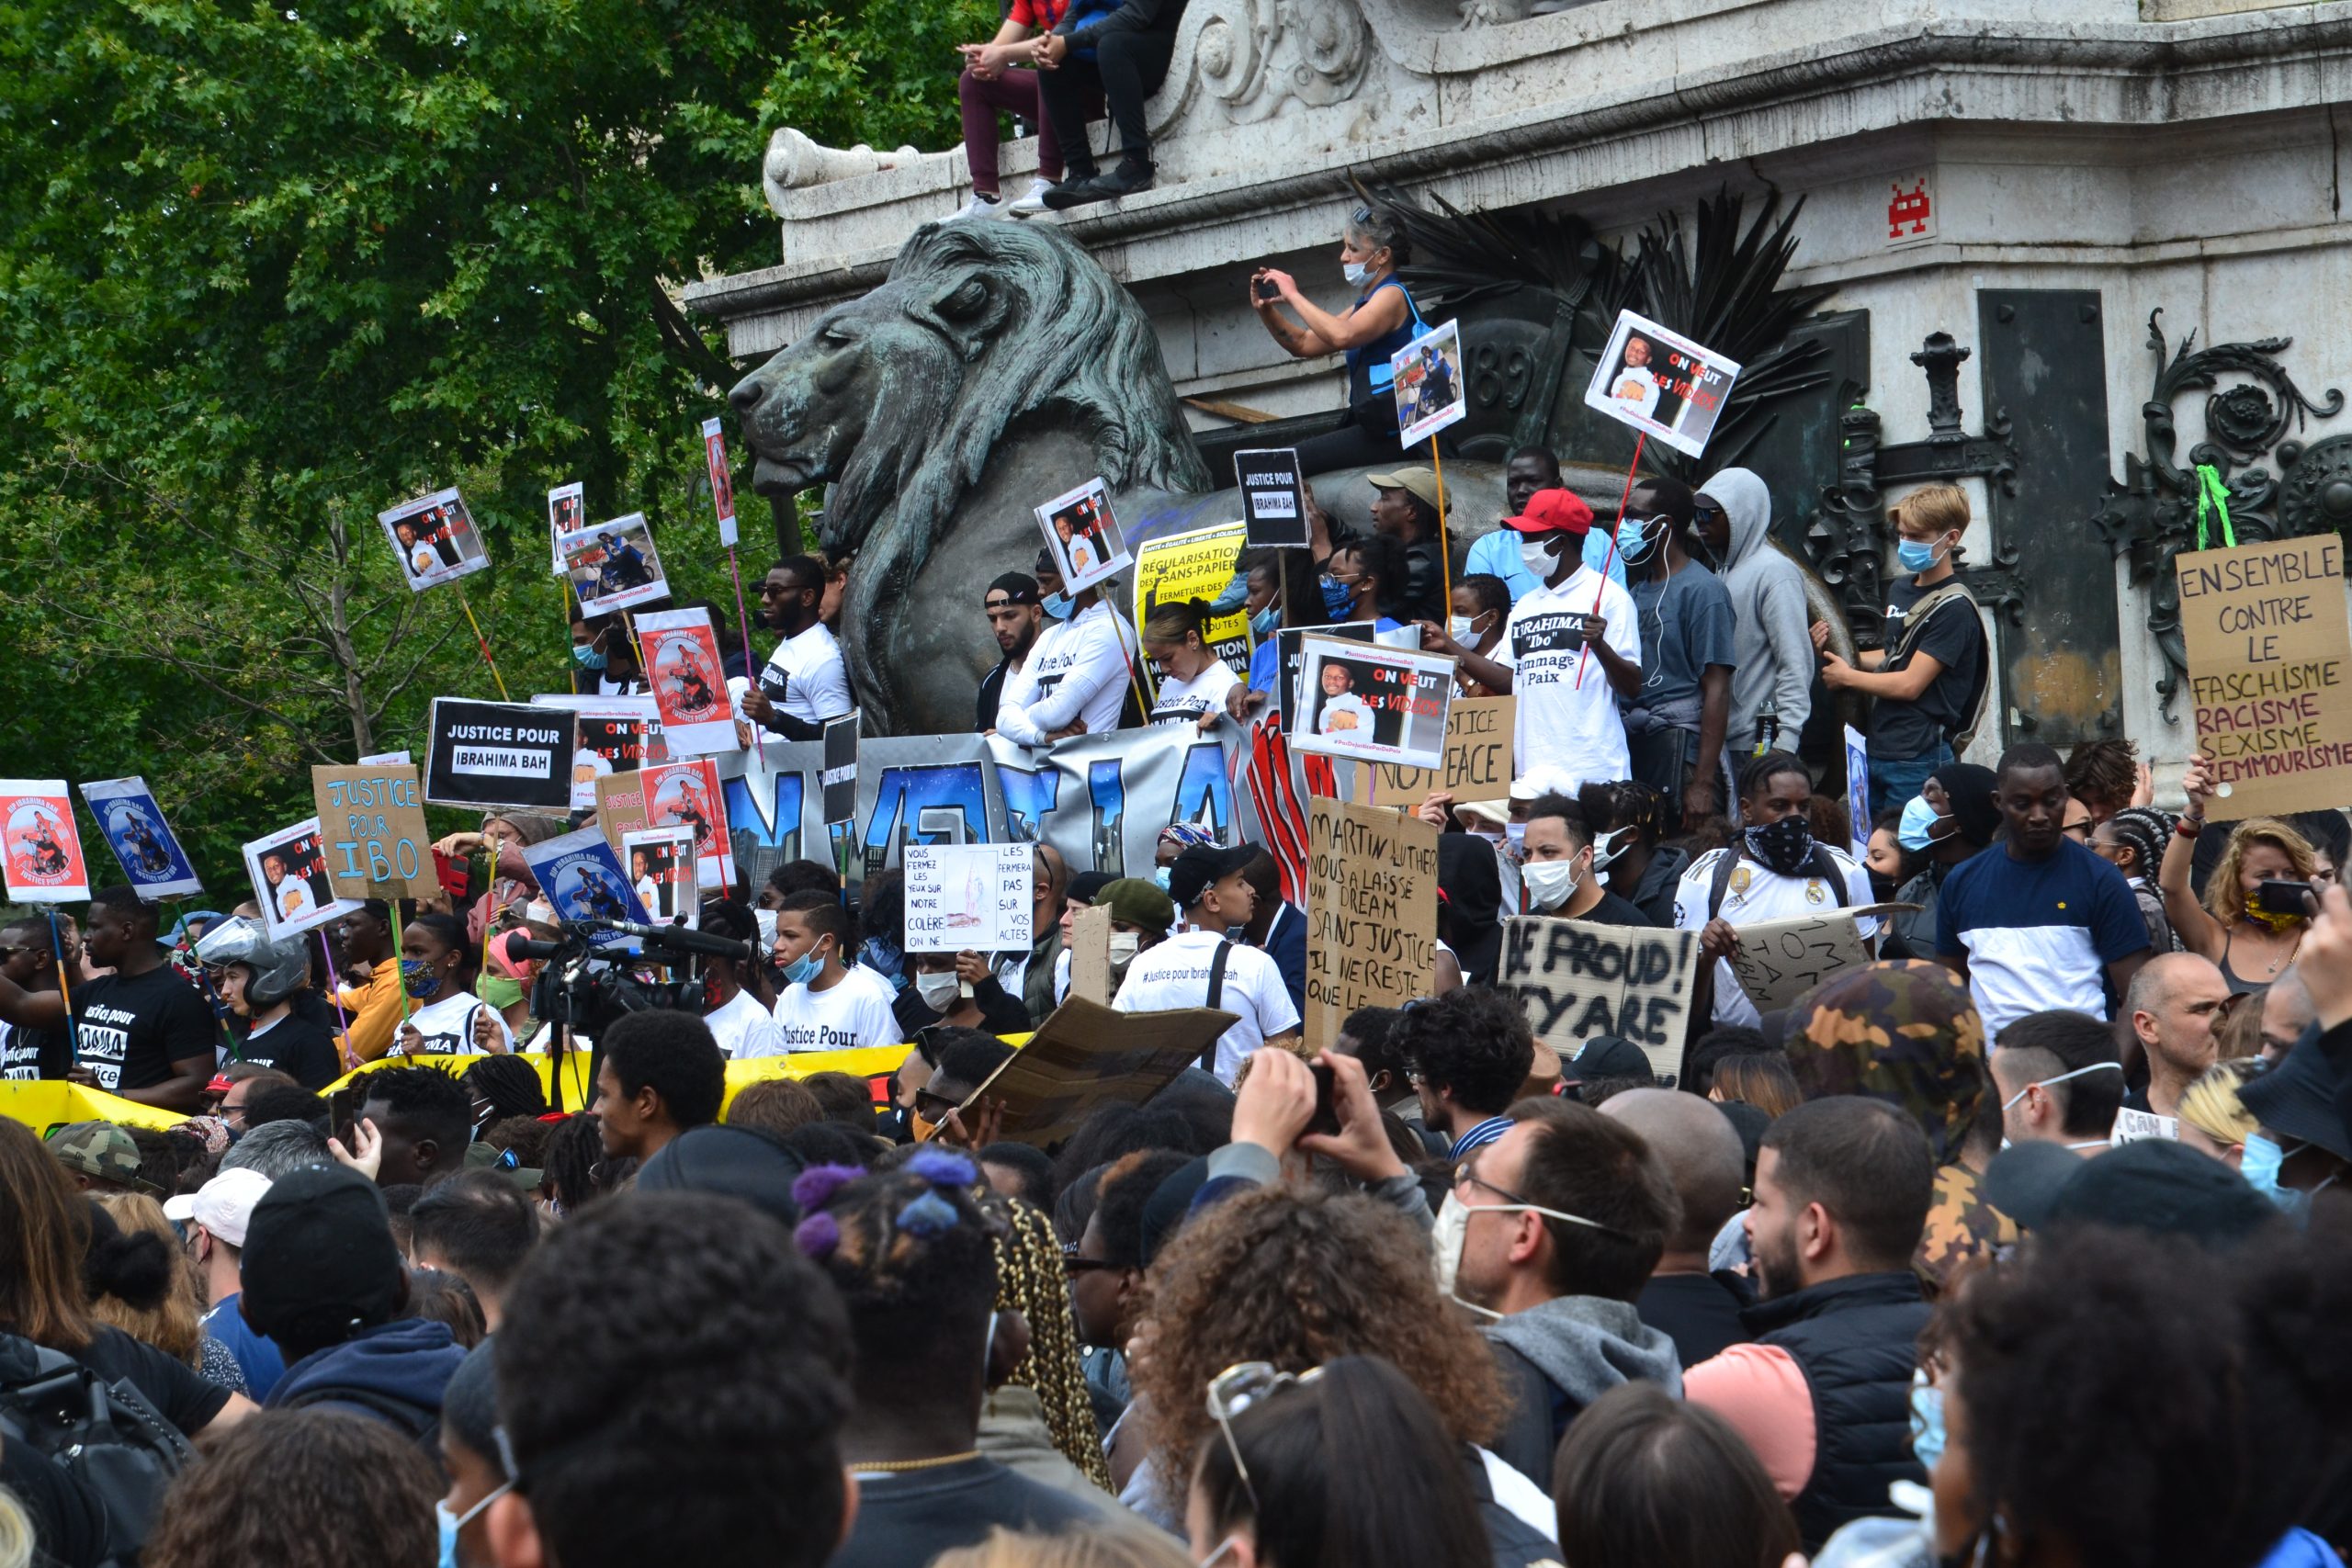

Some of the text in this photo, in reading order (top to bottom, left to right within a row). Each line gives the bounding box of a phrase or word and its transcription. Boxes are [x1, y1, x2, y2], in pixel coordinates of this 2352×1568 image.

[1669, 353, 1722, 386] ON VEUT
[1653, 372, 1673, 389] LES
[1246, 472, 1294, 486] JUSTICE POUR
[1254, 496, 1295, 511] IBRAHIMA BAH
[421, 513, 436, 525] ON
[435, 504, 457, 519] VEUT
[423, 533, 437, 545] LES
[1216, 526, 1247, 538] SOLIDARIT
[1139, 559, 1237, 588] DES SANS-PAPIER
[2180, 546, 2341, 598] ENSEMBLE
[1159, 586, 1205, 602] FERMETURE
[1207, 581, 1223, 592] DES
[2219, 595, 2312, 634] CONTRE
[2248, 636, 2281, 663] LE
[1373, 669, 1437, 689] ON VEUT
[1527, 670, 1560, 685] Paix
[1361, 694, 1385, 708] LES
[447, 725, 560, 744] JUSTICE POUR
[605, 723, 628, 735] ON
[456, 751, 548, 770] IBRAHIMA BAH
[598, 747, 619, 759] LES
[662, 766, 691, 781] IBRAHIMA
[326, 778, 420, 807] JUSTICE
[605, 792, 643, 809] JUSTICE
[17, 796, 45, 807] IBRAHIMA
[347, 815, 390, 838] POUR
[616, 818, 643, 835] POUR
[294, 838, 311, 853] ON
[656, 844, 669, 859] ON
[669, 843, 687, 858] VEUT
[908, 848, 929, 858] VOUS
[1002, 846, 1023, 857] LES
[335, 838, 419, 883] IBO
[555, 852, 584, 869] IBRAHIMA
[907, 860, 937, 870] FERMEZ
[1391, 839, 1437, 876] LUTHER
[295, 864, 312, 881] LES
[913, 873, 928, 881] LES
[998, 863, 1031, 874] FERMERA
[1309, 853, 1347, 885] NOUS
[1350, 871, 1358, 890] A
[21, 869, 46, 886] JUSTICE
[651, 873, 664, 886] LES
[1003, 879, 1023, 891] PAS
[908, 885, 942, 893] YEUX SUR
[910, 898, 938, 908] NOTRE
[999, 899, 1018, 910] SUR
[1309, 883, 1397, 919] UN DREAM
[908, 914, 945, 931] COLÈRE
[1010, 914, 1030, 925] VOS
[1313, 908, 1360, 948] SANS
[910, 936, 941, 947] ON NE
[999, 930, 1028, 941] ACTES
[1143, 967, 1171, 984] #Justice
[1171, 969, 1190, 982] pour
[1309, 950, 1419, 998] IL NE RESTE
[1308, 978, 1340, 1007] QUE
[106, 1010, 136, 1025] pour
[1572, 995, 1681, 1045] ARE
[819, 1024, 857, 1047] Pour
